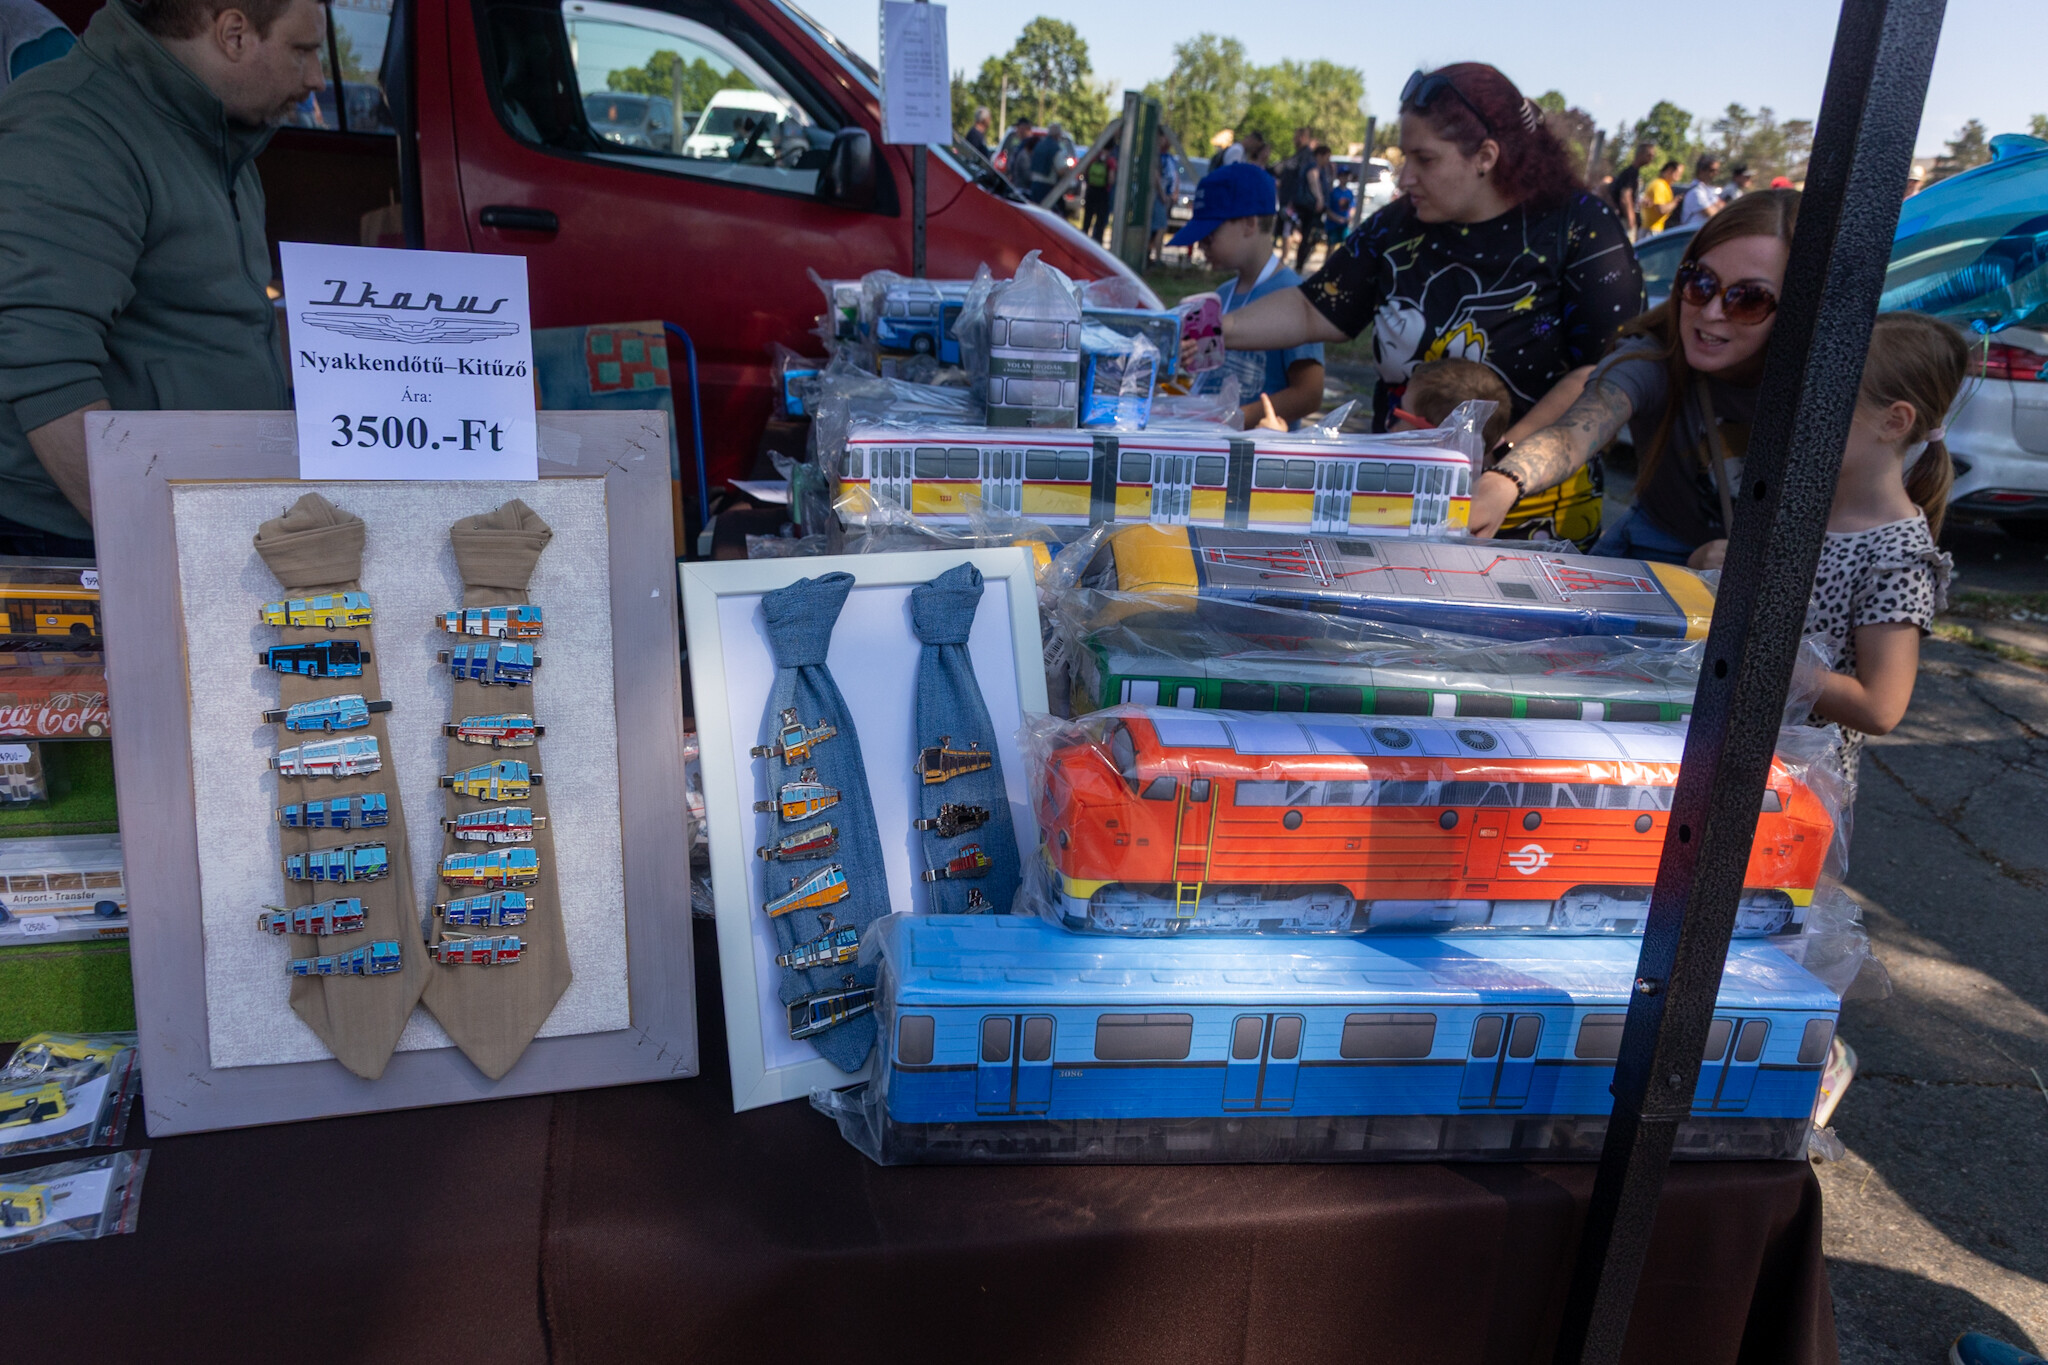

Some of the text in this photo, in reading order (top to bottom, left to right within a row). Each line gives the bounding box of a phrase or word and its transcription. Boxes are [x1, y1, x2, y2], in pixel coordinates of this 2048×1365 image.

[309, 279, 508, 314] Ikarus
[401, 386, 432, 403] Ára:
[331, 414, 504, 452] 3500.-Ft
[13, 893, 47, 904] Airport
[55, 892, 96, 901] Transfer
[1059, 1070, 1083, 1078] 3086
